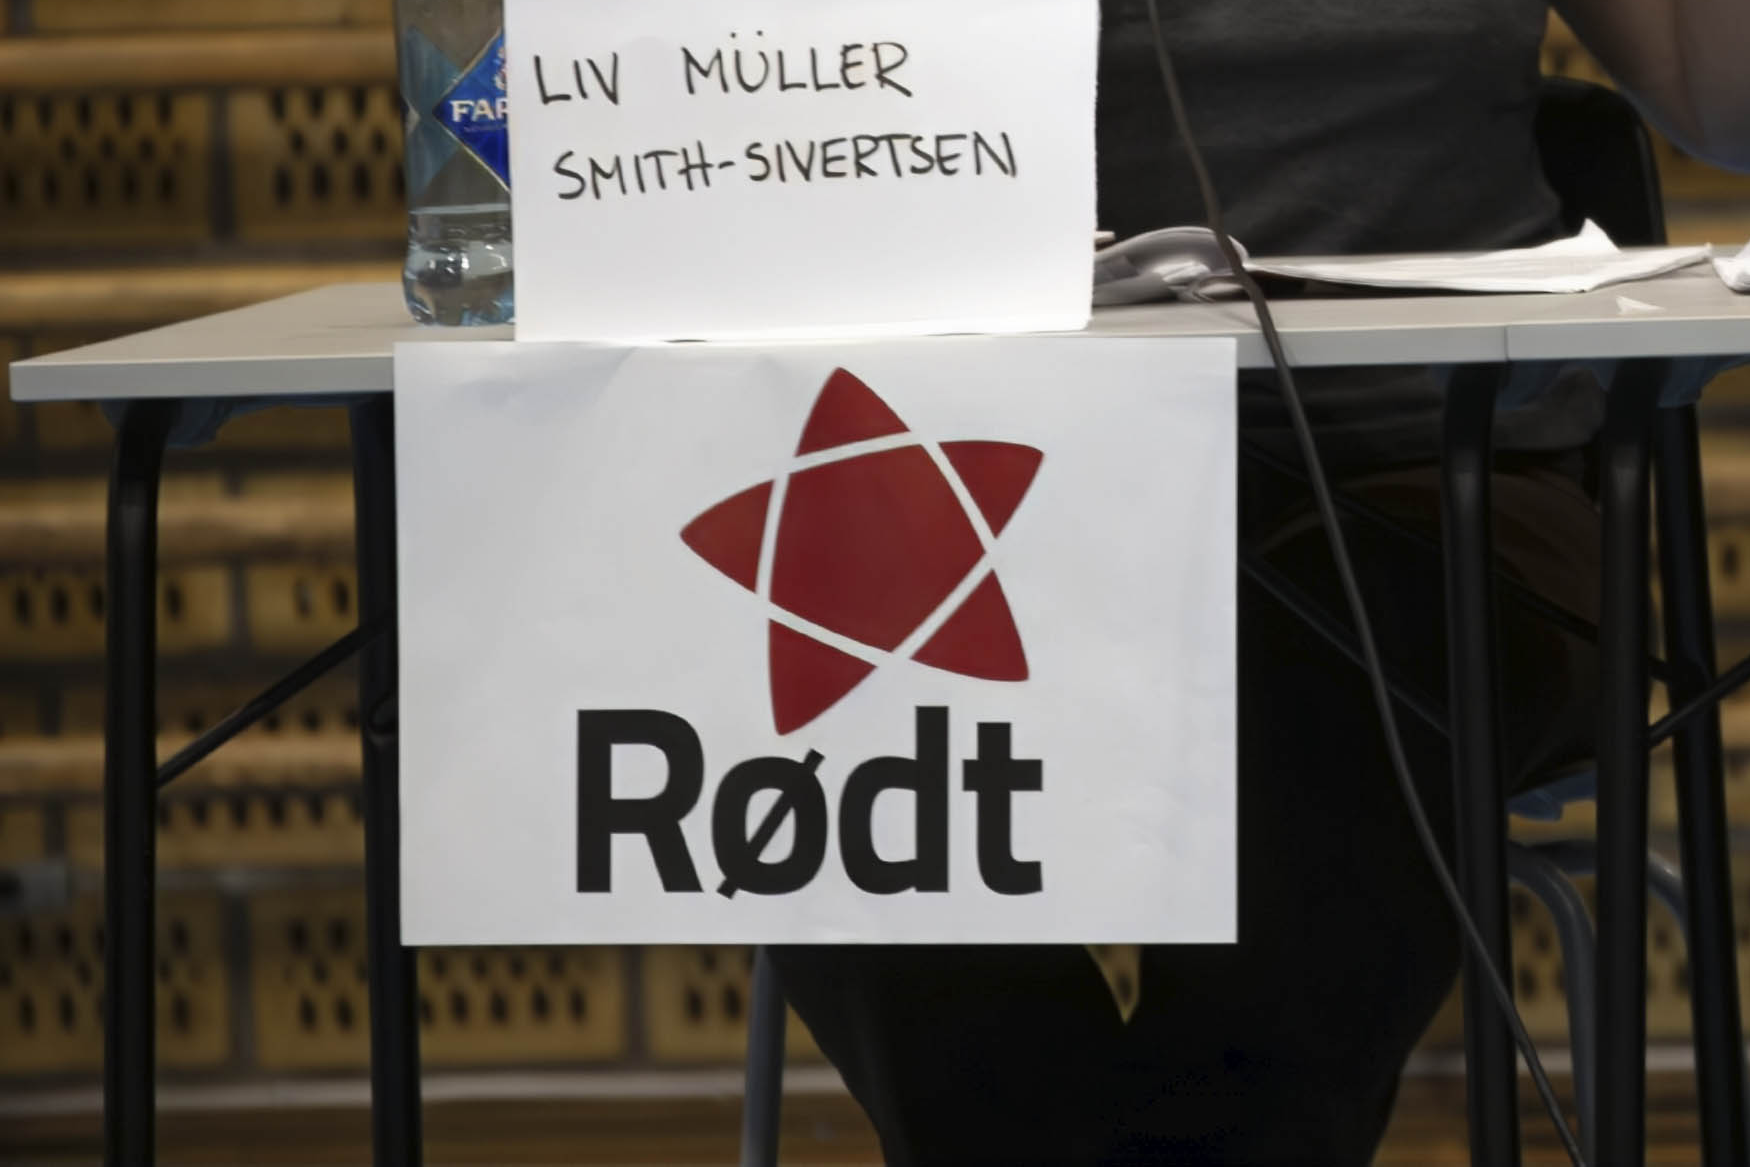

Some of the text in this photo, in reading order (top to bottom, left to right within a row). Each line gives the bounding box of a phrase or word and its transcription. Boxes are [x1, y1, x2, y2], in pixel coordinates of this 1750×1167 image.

[532, 30, 913, 106] LIV MÜLLER
[552, 130, 1018, 201] SMITH-SIVERTSEN
[576, 705, 1044, 899] Rødt
